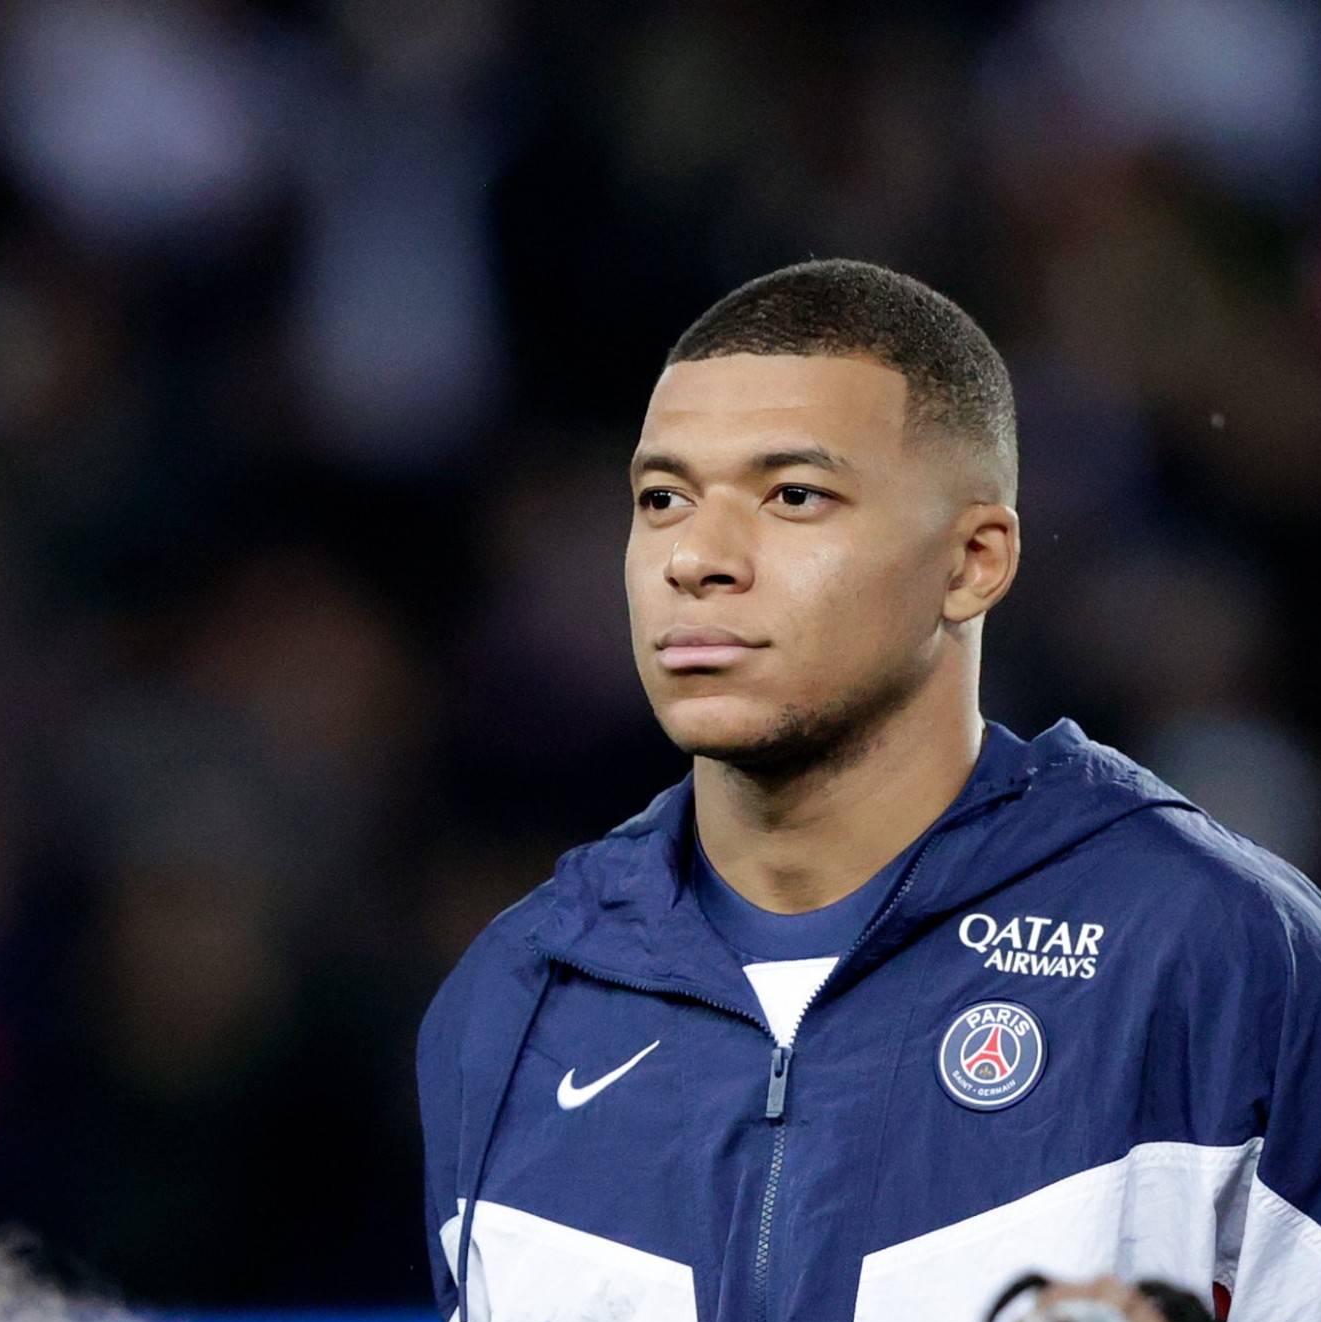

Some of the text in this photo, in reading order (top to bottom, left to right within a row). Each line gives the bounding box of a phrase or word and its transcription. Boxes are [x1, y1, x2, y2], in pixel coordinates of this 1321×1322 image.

[959, 913, 1105, 953] QATAR
[984, 949, 1097, 979] AIRWAYS
[965, 1008, 1031, 1037] PARIS
